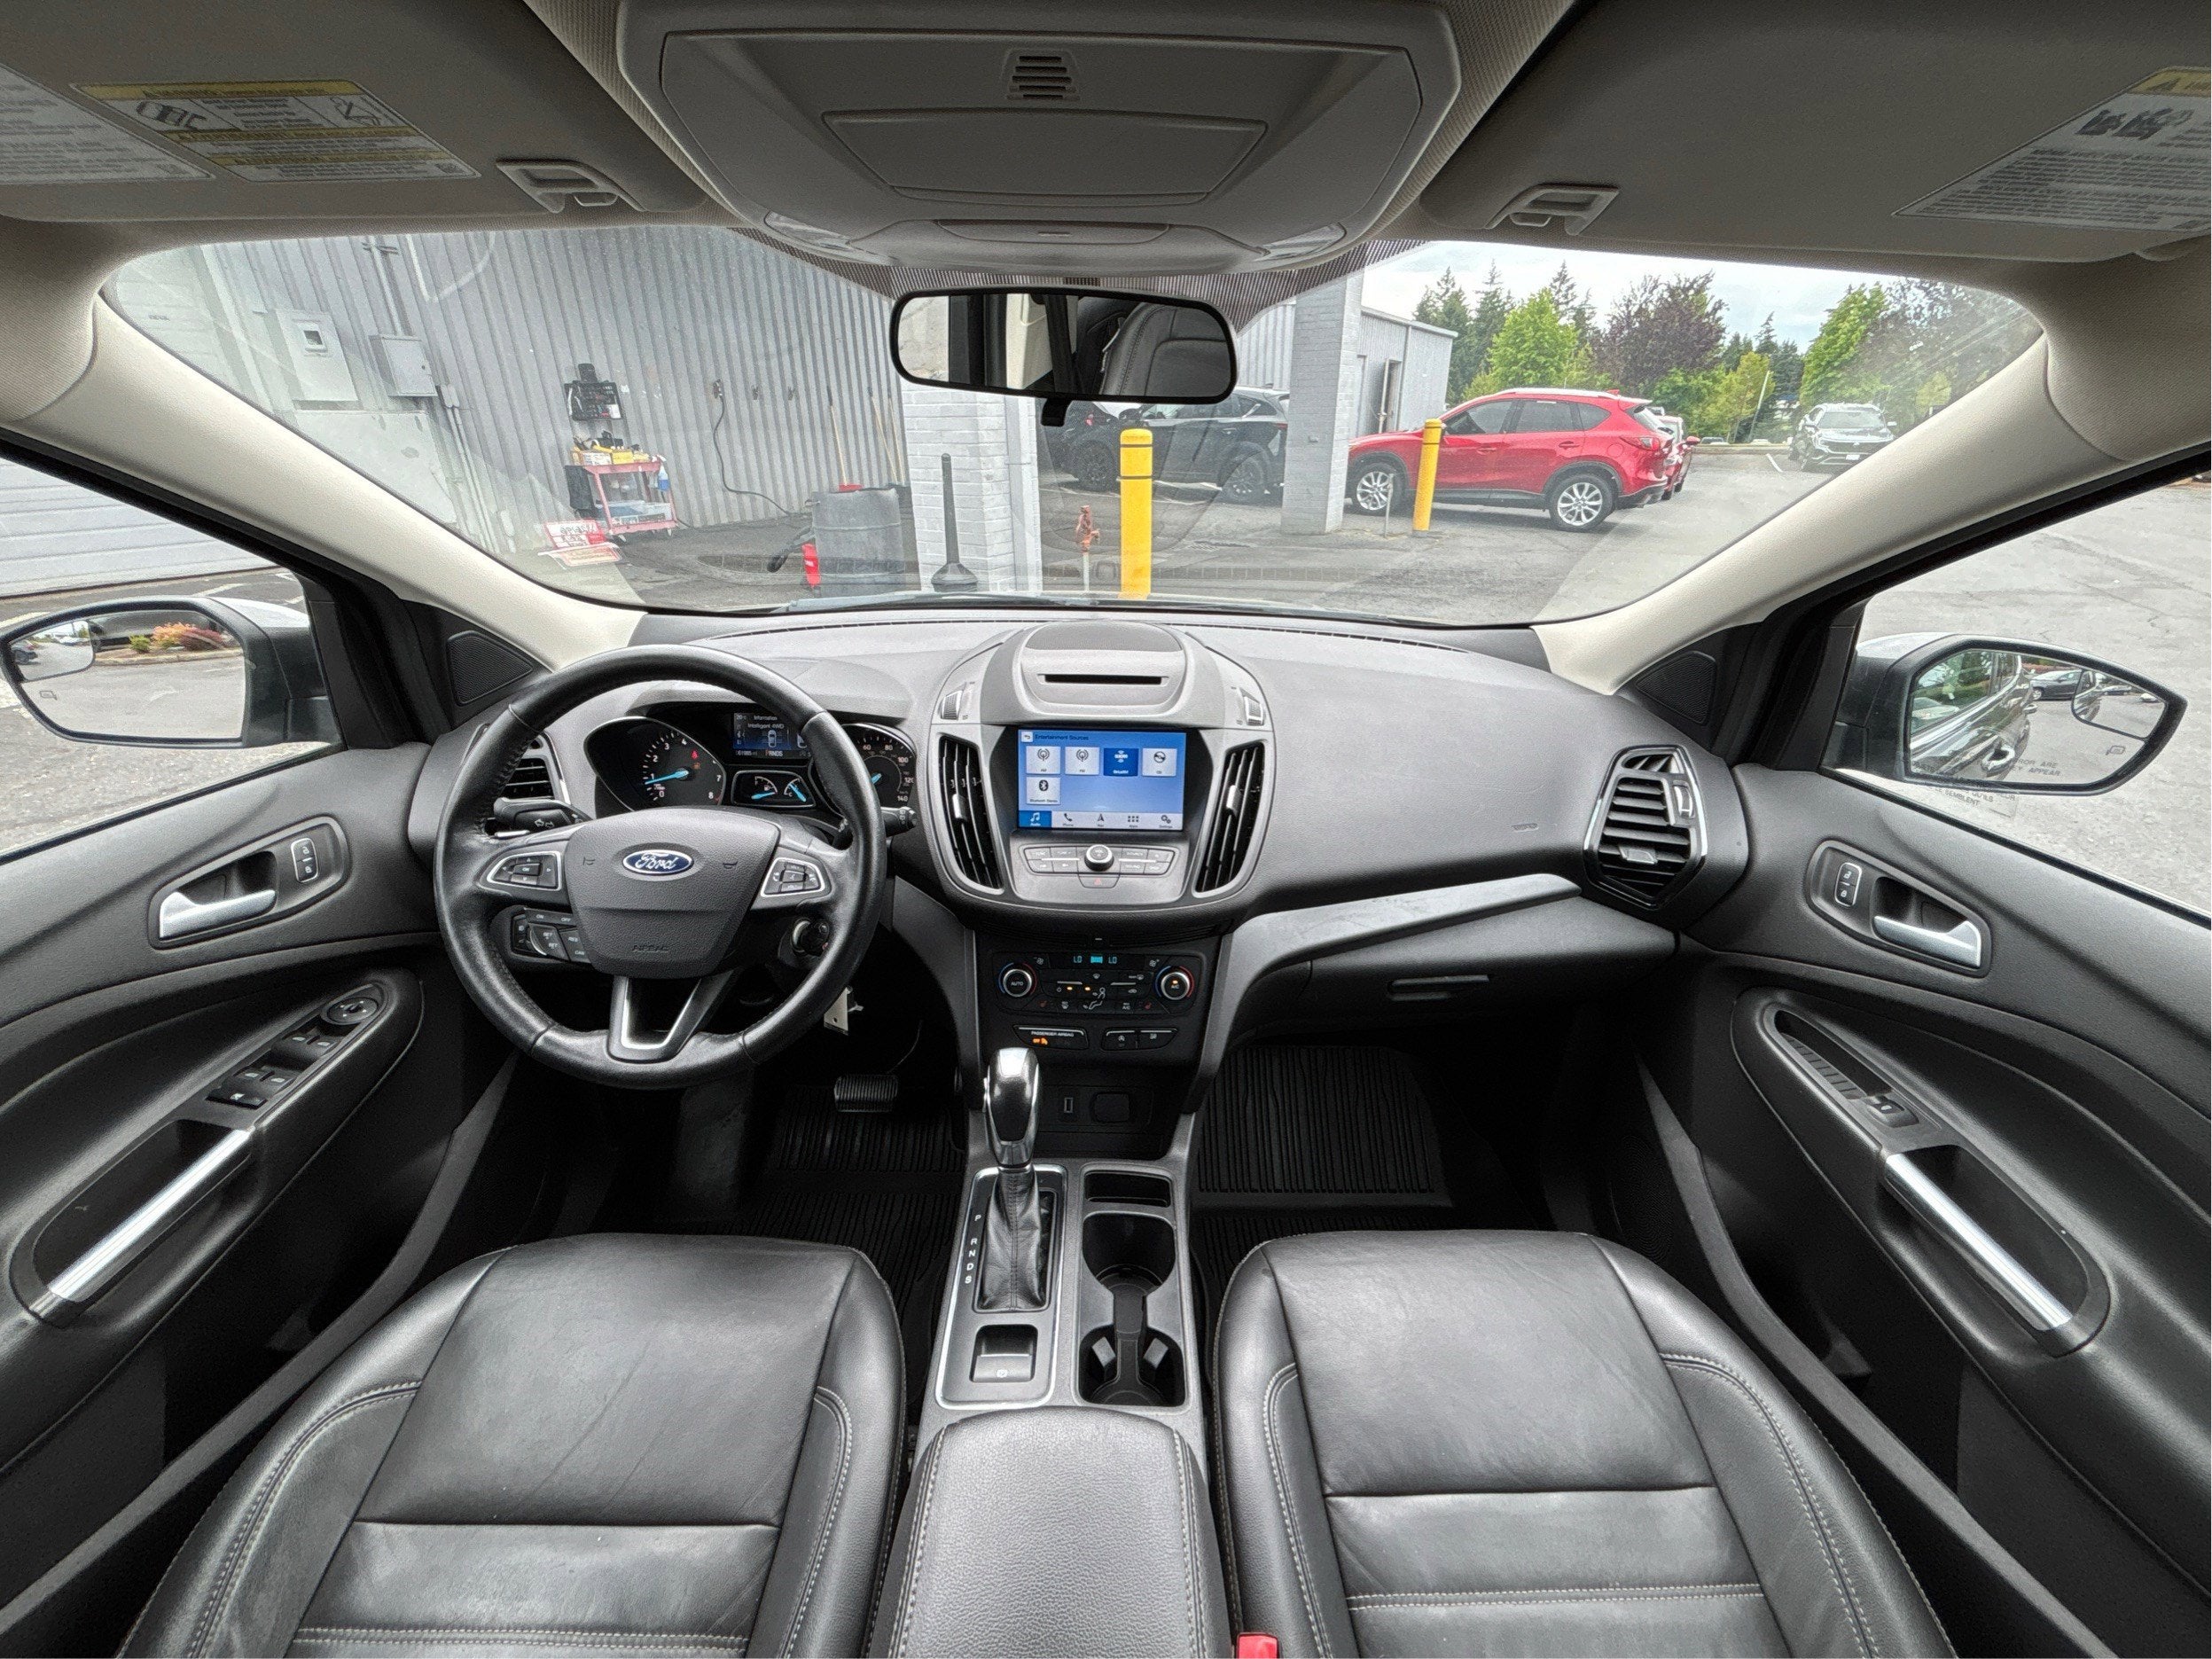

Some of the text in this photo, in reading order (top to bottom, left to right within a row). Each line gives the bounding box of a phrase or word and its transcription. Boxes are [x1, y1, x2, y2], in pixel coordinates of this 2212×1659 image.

[2028, 767, 2061, 777] APPEAR
[1944, 787, 1981, 806] SEMBLENT
[635, 852, 679, 870] Ford
[1073, 955, 1083, 964] LO
[1108, 956, 1117, 965] LO
[966, 1263, 974, 1272] D
[965, 1275, 973, 1284] S
